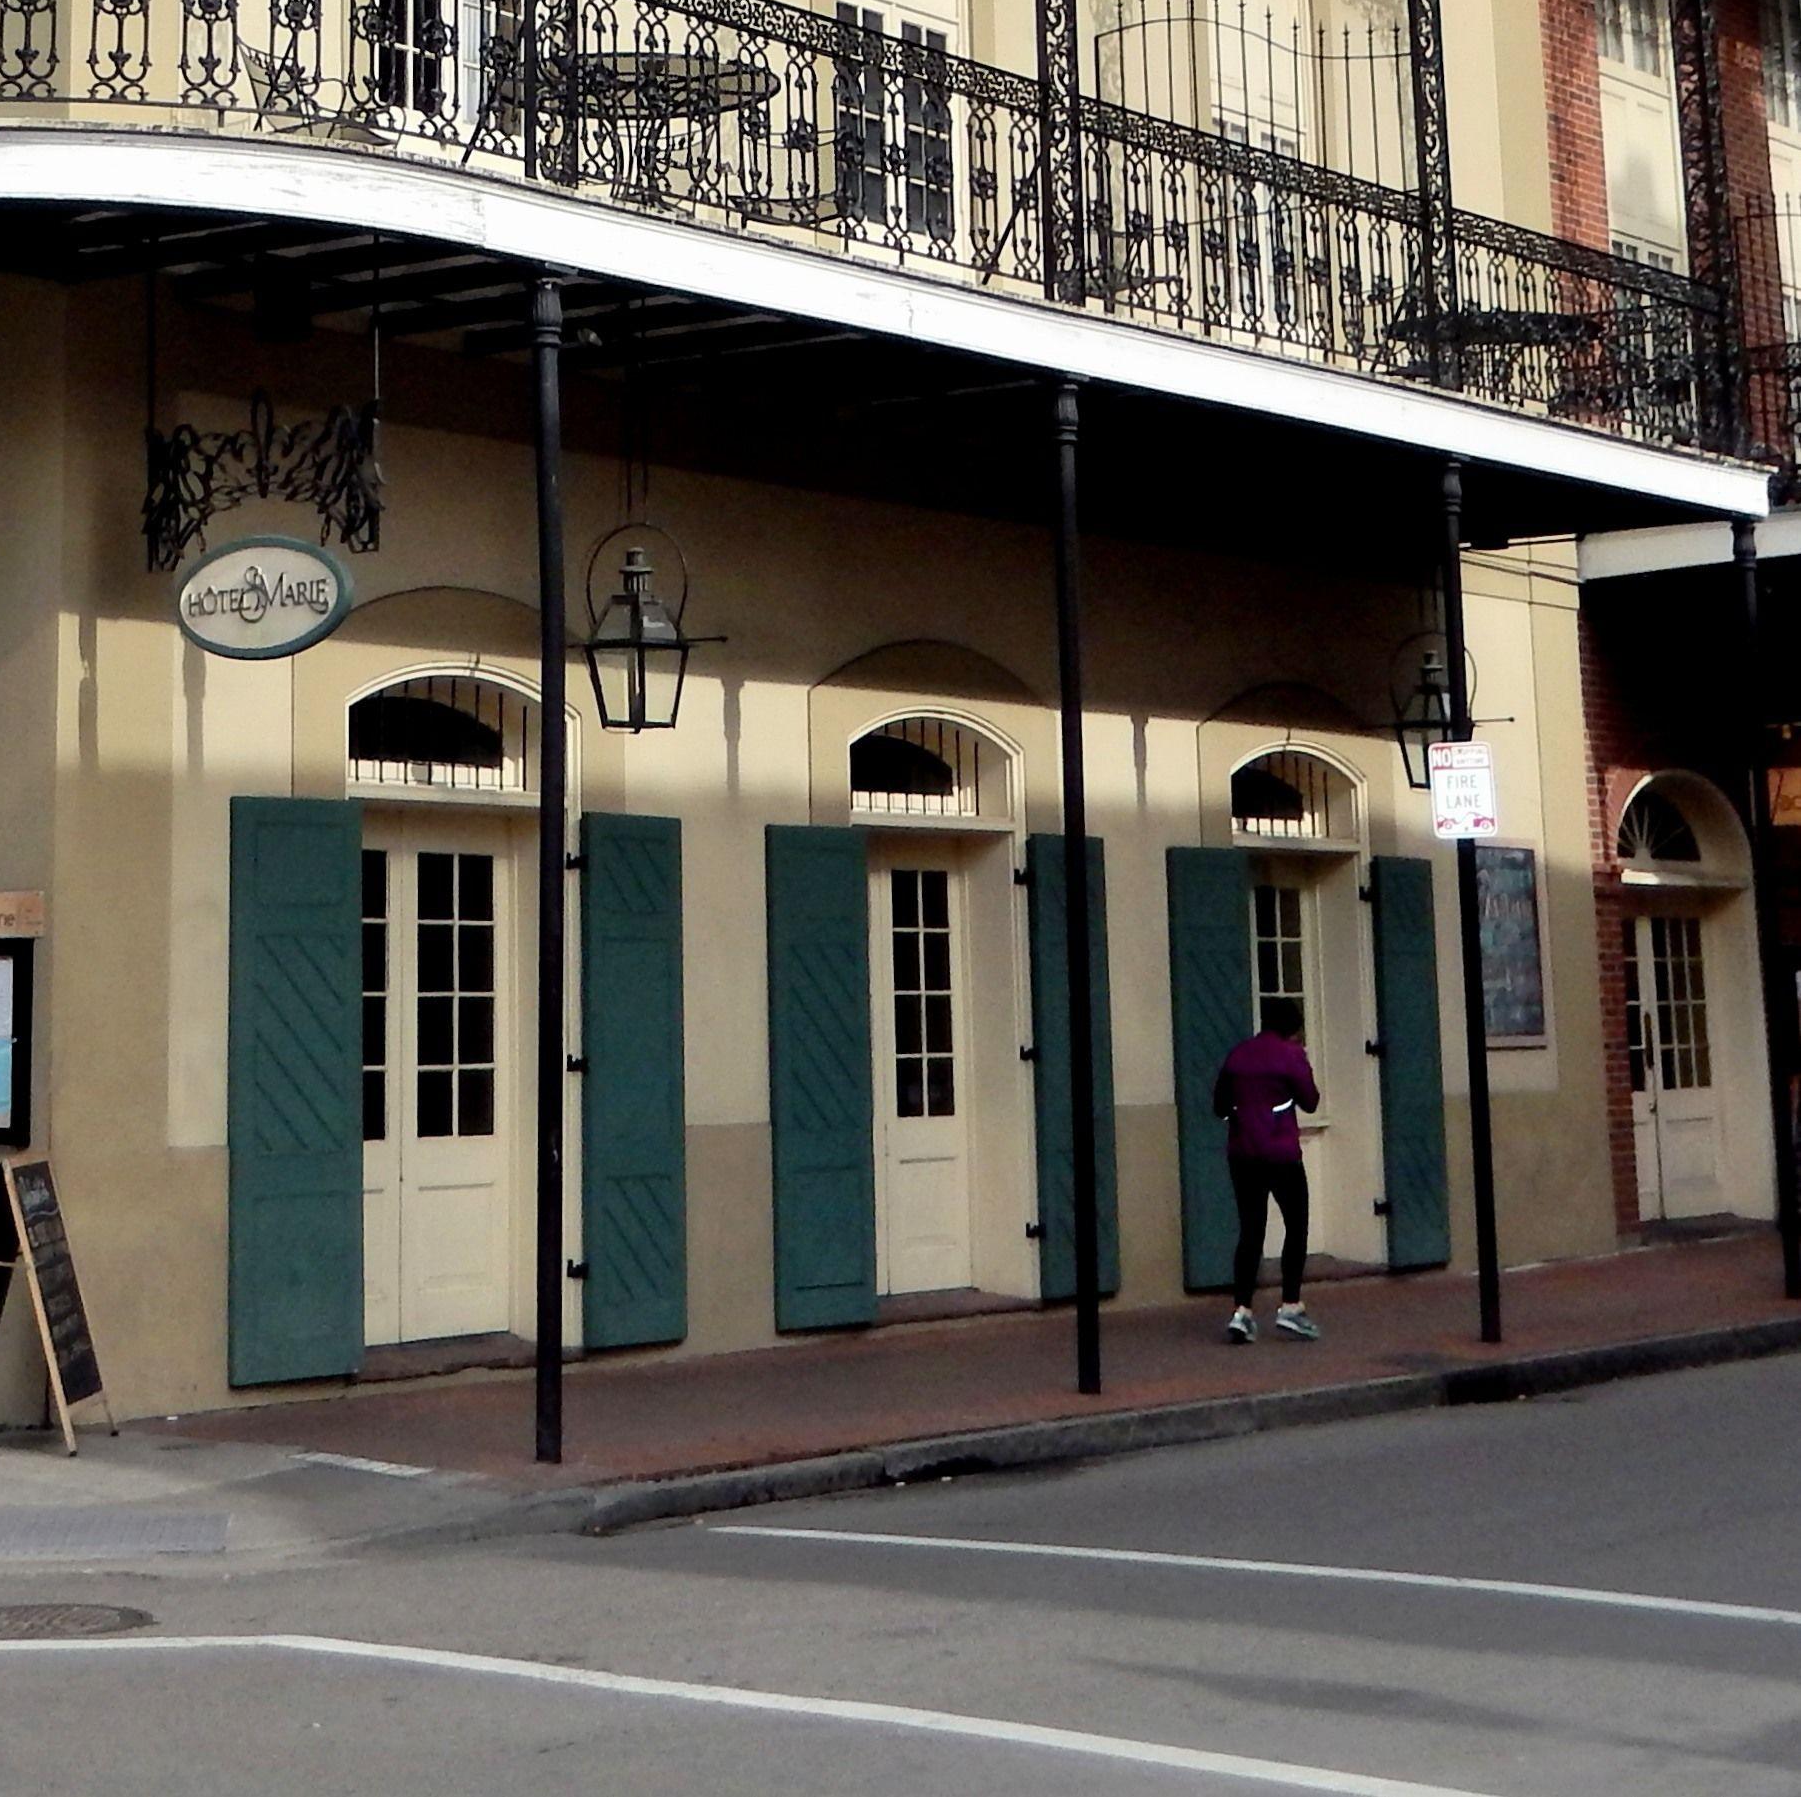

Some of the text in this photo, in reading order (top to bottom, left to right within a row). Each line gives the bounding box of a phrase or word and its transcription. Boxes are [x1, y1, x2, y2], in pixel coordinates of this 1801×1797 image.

[256, 572, 329, 614] MARIE
[1432, 748, 1452, 768] NO
[1447, 775, 1477, 789] FIRE
[1446, 794, 1481, 809] LANE
